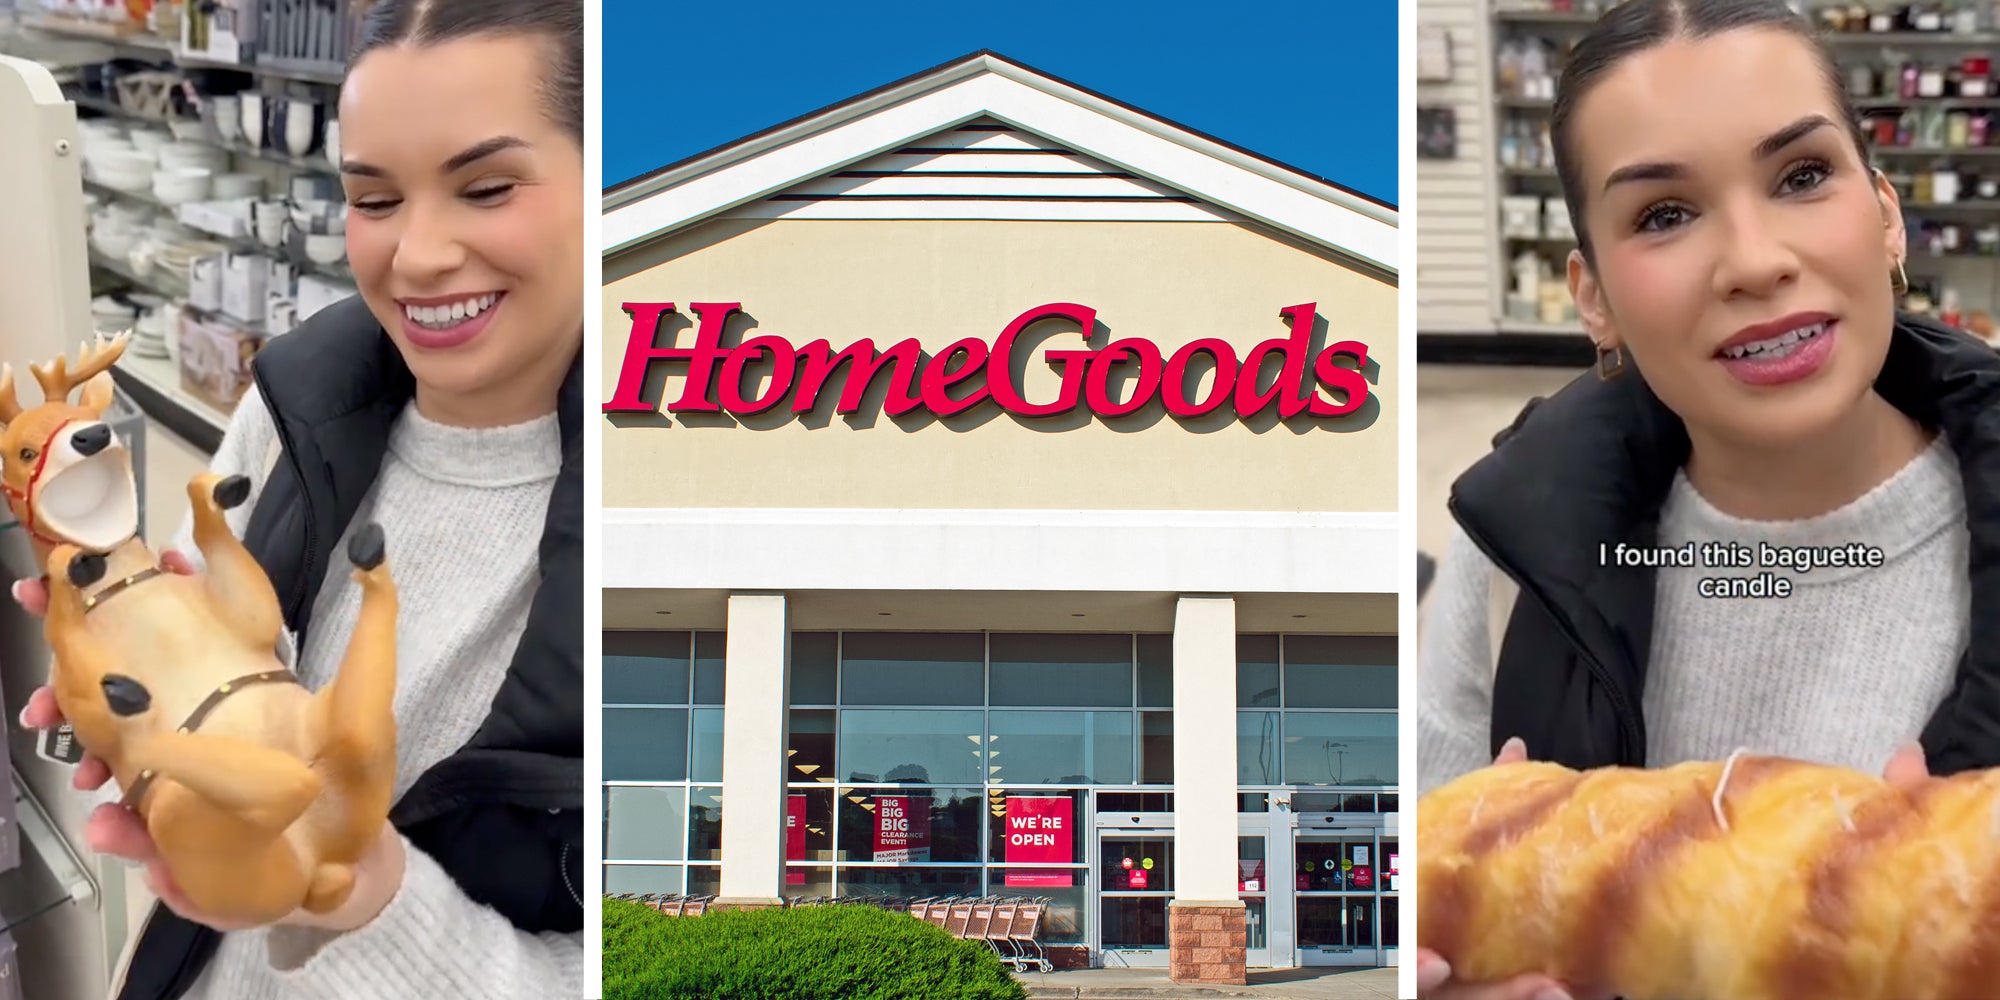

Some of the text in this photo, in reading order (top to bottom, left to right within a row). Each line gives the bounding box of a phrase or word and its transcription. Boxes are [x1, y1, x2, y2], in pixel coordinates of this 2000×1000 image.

[603, 302, 1369, 417] HomeGoods
[881, 799, 899, 807] BIG
[881, 808, 903, 817] BIG
[881, 819, 909, 831] BIG
[1011, 814, 1062, 829] WE'RE
[1011, 834, 1055, 846] OPEN
